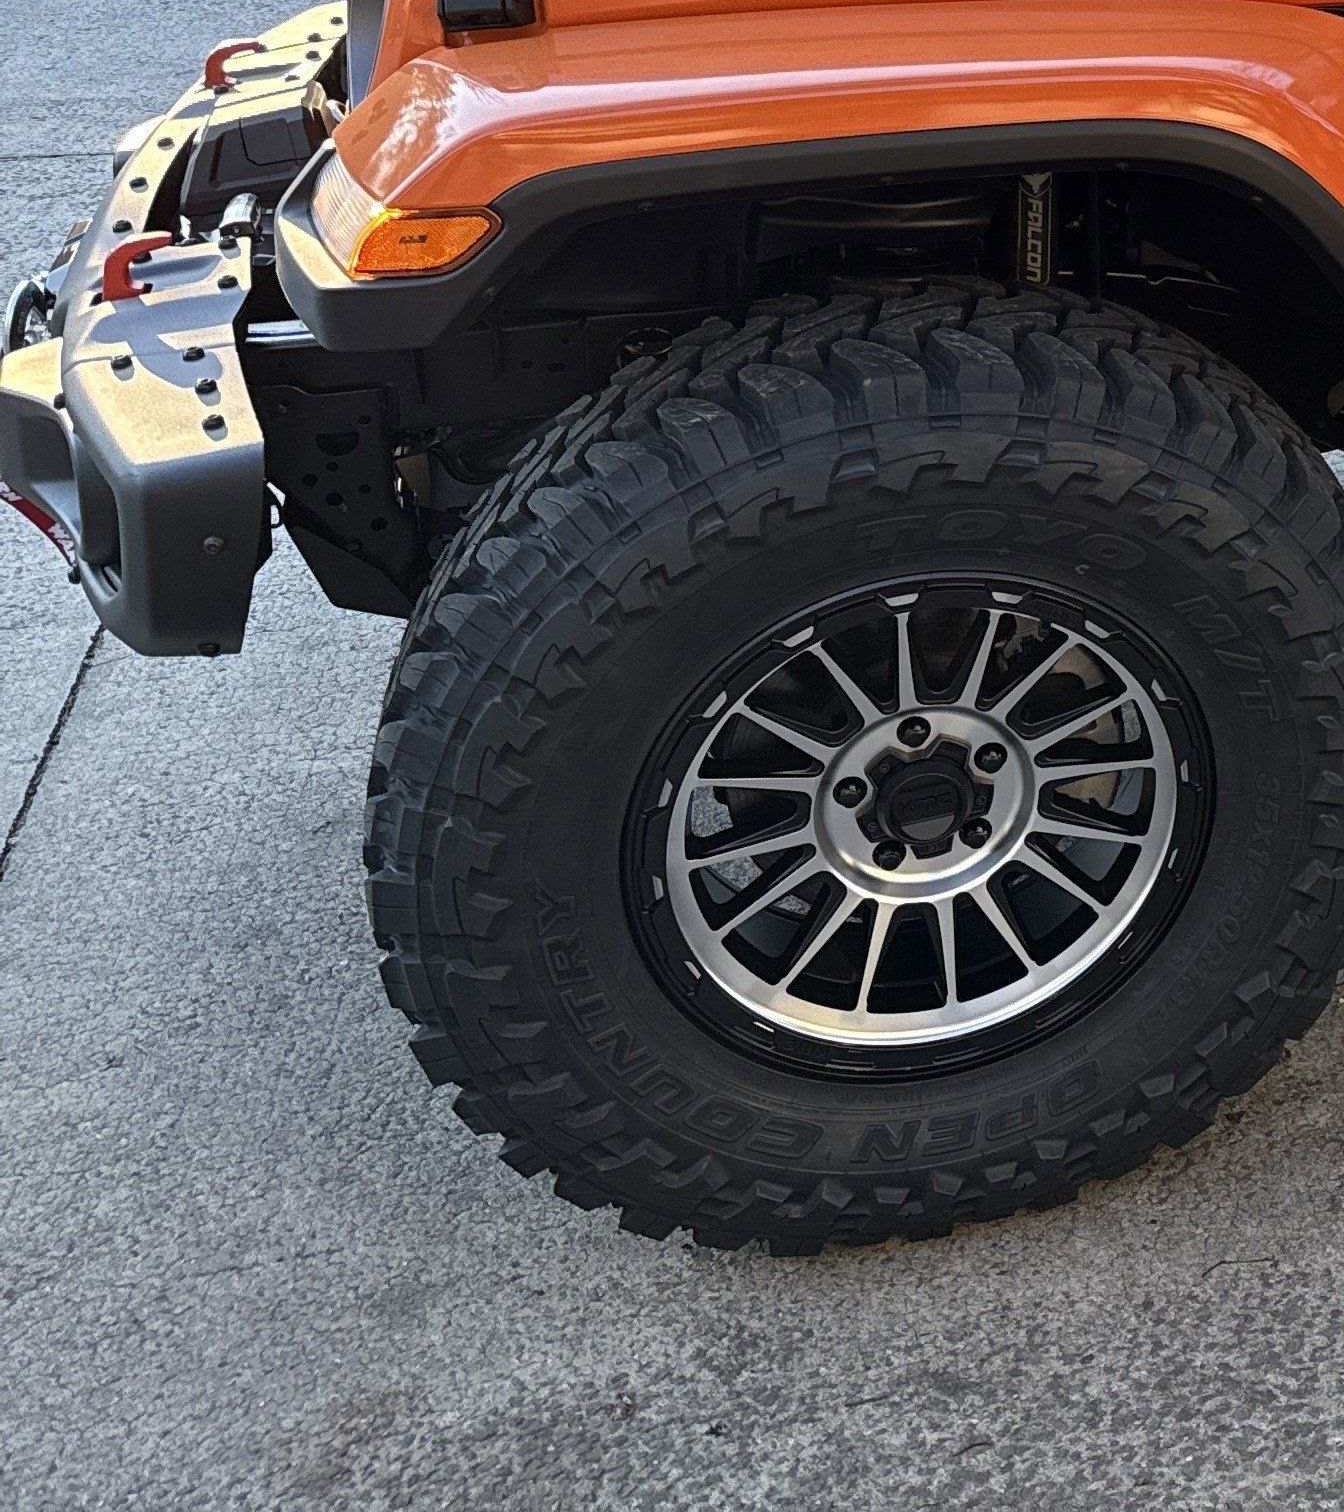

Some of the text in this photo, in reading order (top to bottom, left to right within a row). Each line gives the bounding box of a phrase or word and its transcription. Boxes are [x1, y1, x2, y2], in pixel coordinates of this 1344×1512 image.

[1025, 198, 1043, 283] FALCON
[856, 509, 1148, 572] TOYO
[535, 877, 1101, 1164] OPEN COUNTRY
